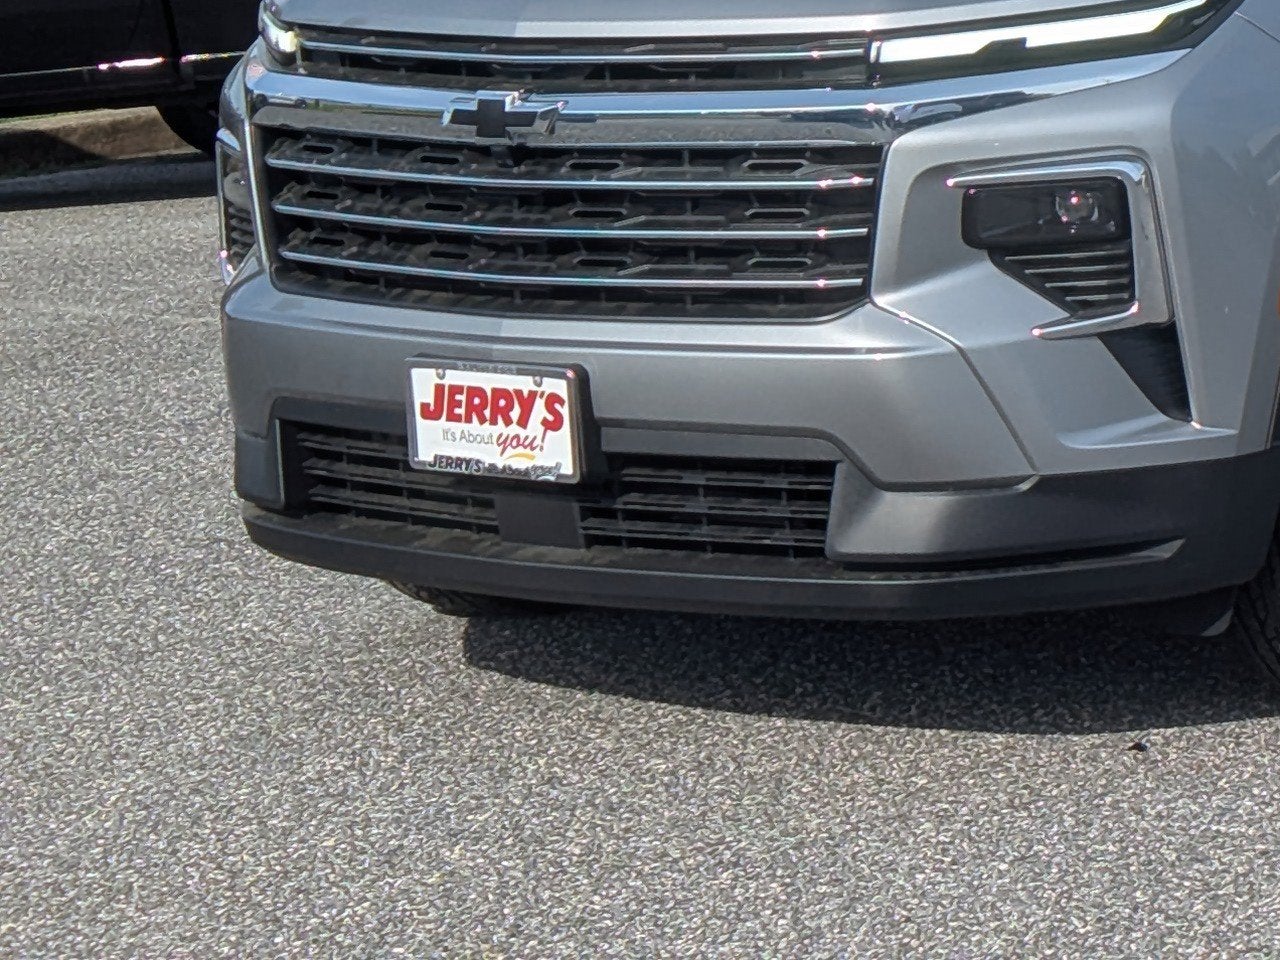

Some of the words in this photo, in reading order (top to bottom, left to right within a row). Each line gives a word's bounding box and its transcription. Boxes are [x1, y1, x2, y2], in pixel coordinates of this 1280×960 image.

[420, 383, 566, 432] JERRY'S
[442, 428, 457, 442] It's
[459, 429, 494, 445] About
[496, 428, 549, 456] you!
